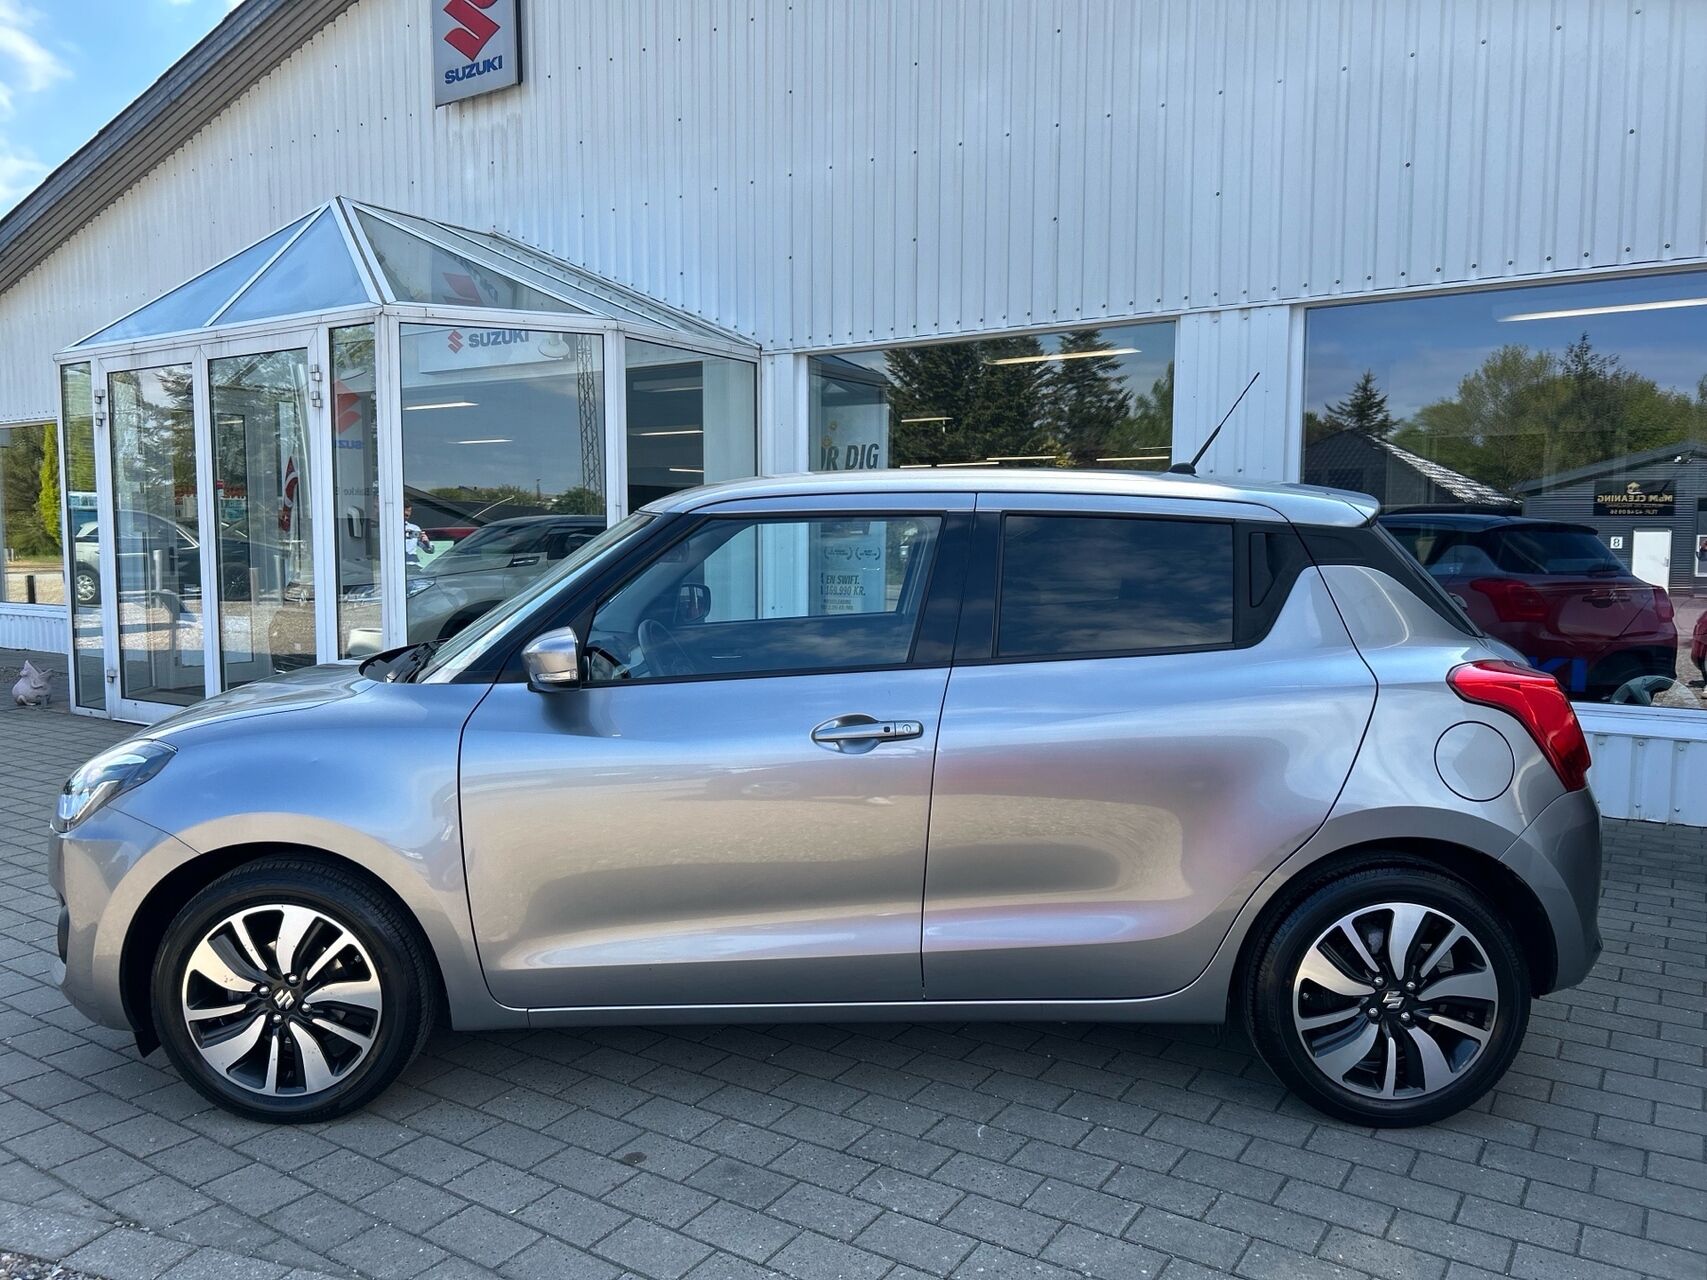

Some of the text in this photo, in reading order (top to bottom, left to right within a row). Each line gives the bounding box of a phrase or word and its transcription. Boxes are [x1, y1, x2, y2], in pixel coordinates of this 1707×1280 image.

[445, 55, 502, 84] SUZUKI
[468, 330, 529, 348] SUZUKI
[845, 443, 879, 470] DIG
